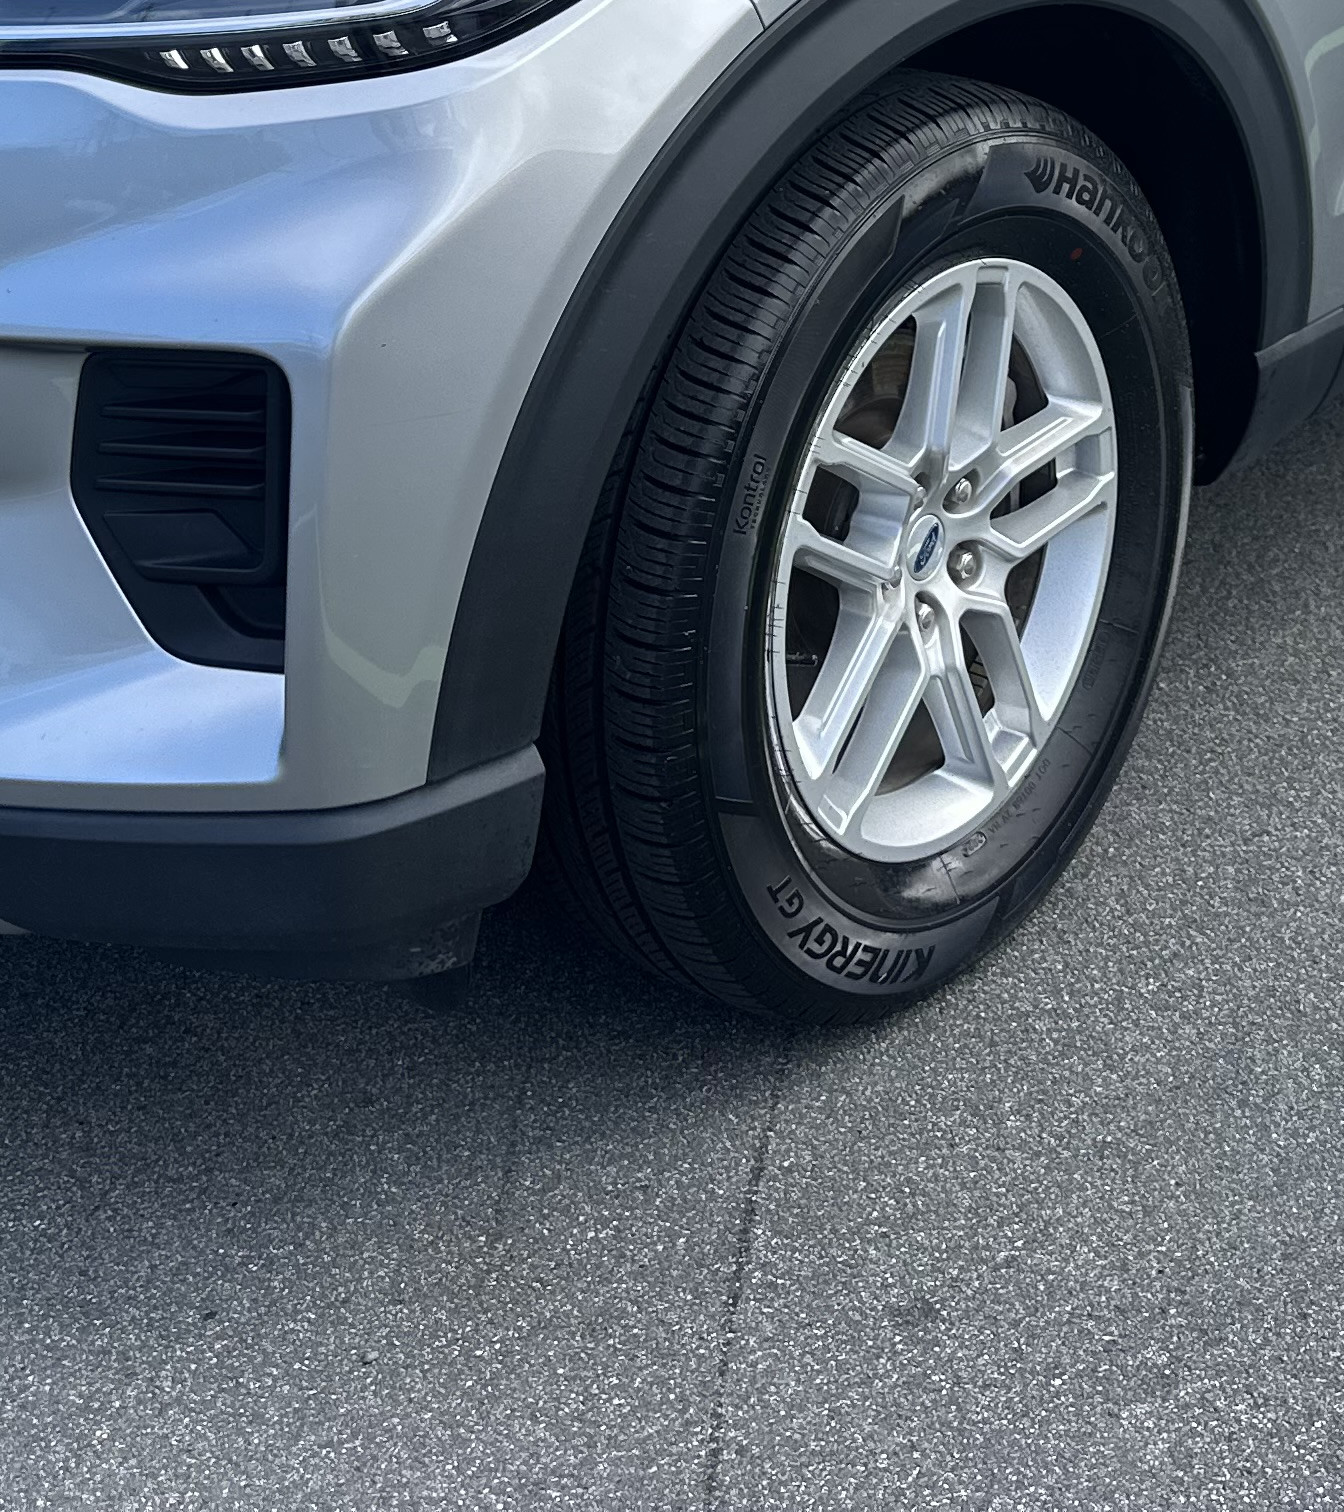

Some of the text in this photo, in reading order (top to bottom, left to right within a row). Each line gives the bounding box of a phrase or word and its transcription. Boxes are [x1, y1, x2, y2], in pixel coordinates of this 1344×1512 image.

[733, 453, 767, 535] Kontrol
[767, 875, 937, 986] KINERGY GT
